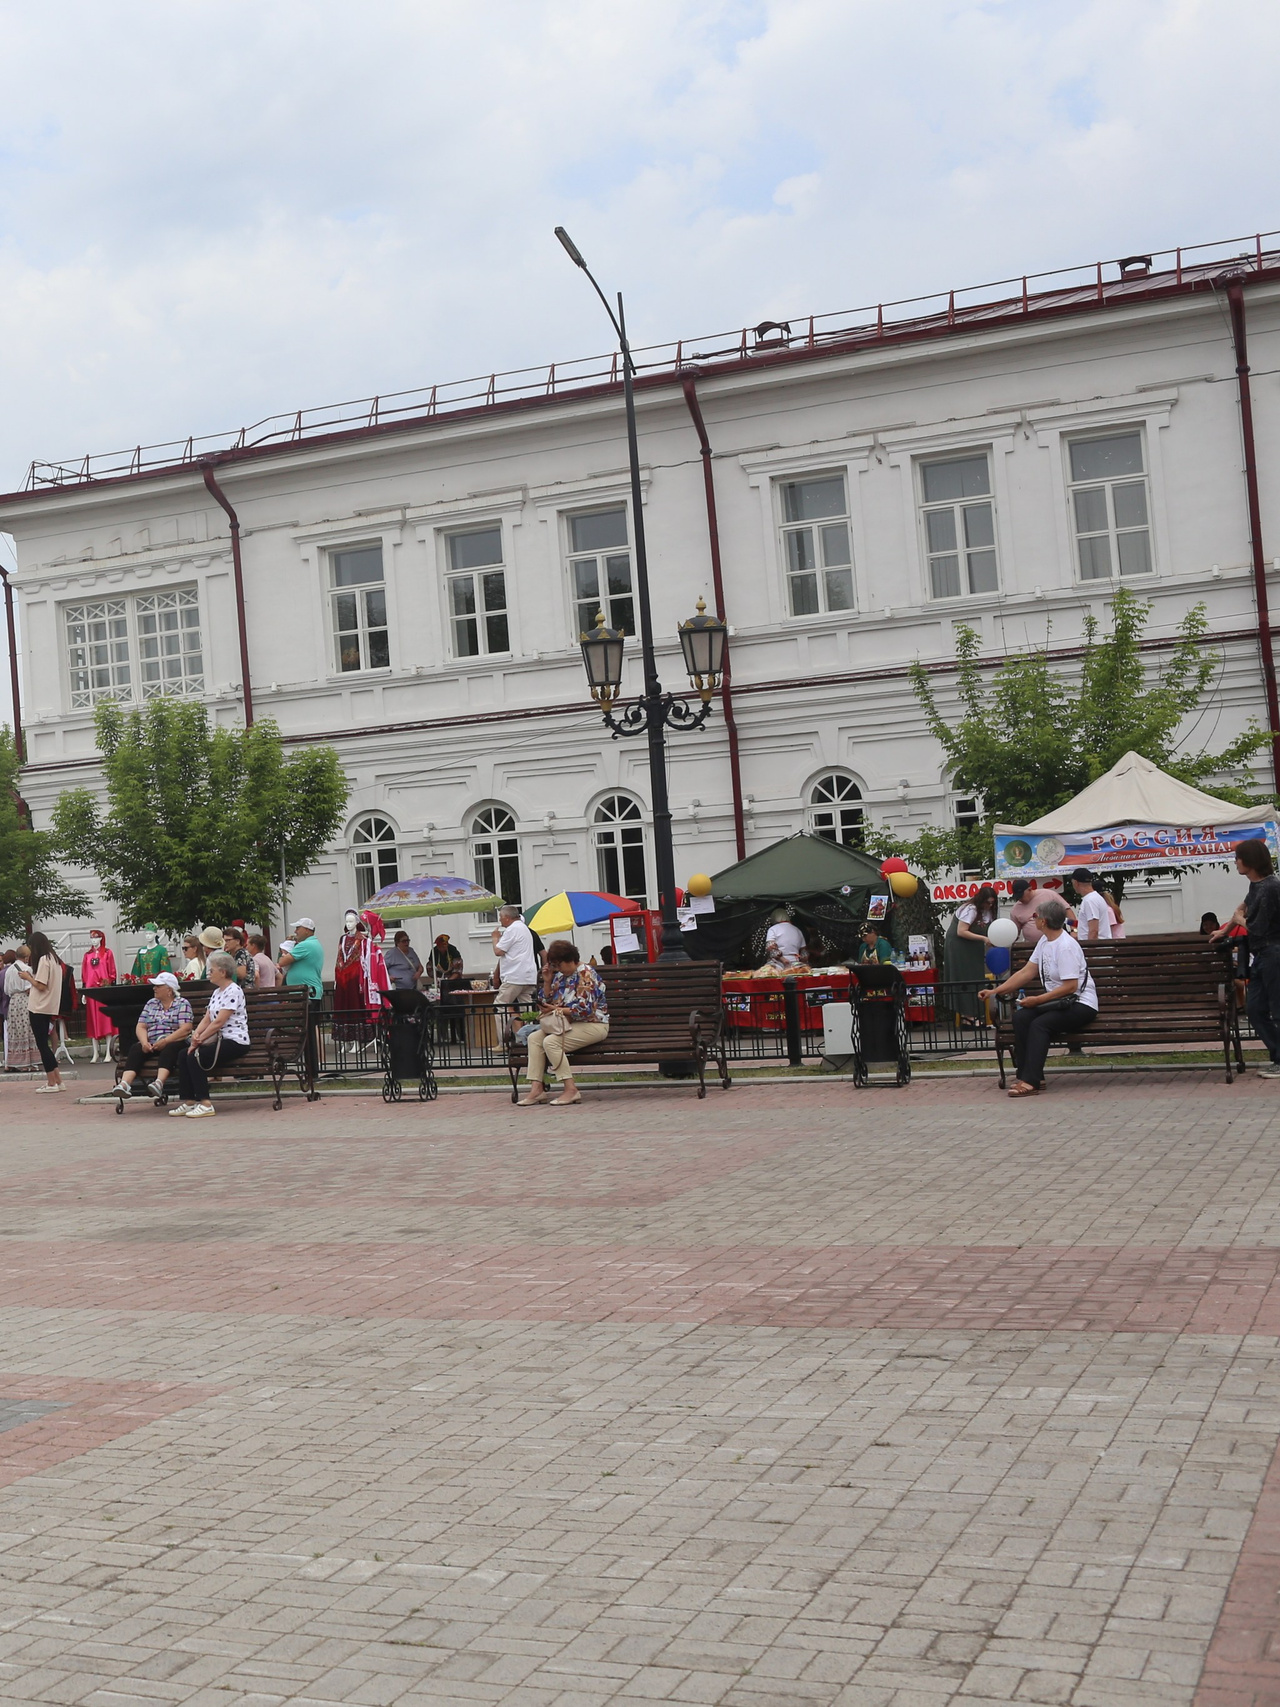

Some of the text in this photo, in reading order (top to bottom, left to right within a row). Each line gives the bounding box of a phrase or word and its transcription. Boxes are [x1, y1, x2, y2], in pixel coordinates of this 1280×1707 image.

[1090, 825, 1217, 853] РОССИЯ
[1090, 842, 1232, 863] Любимая наша СТРАНА!
